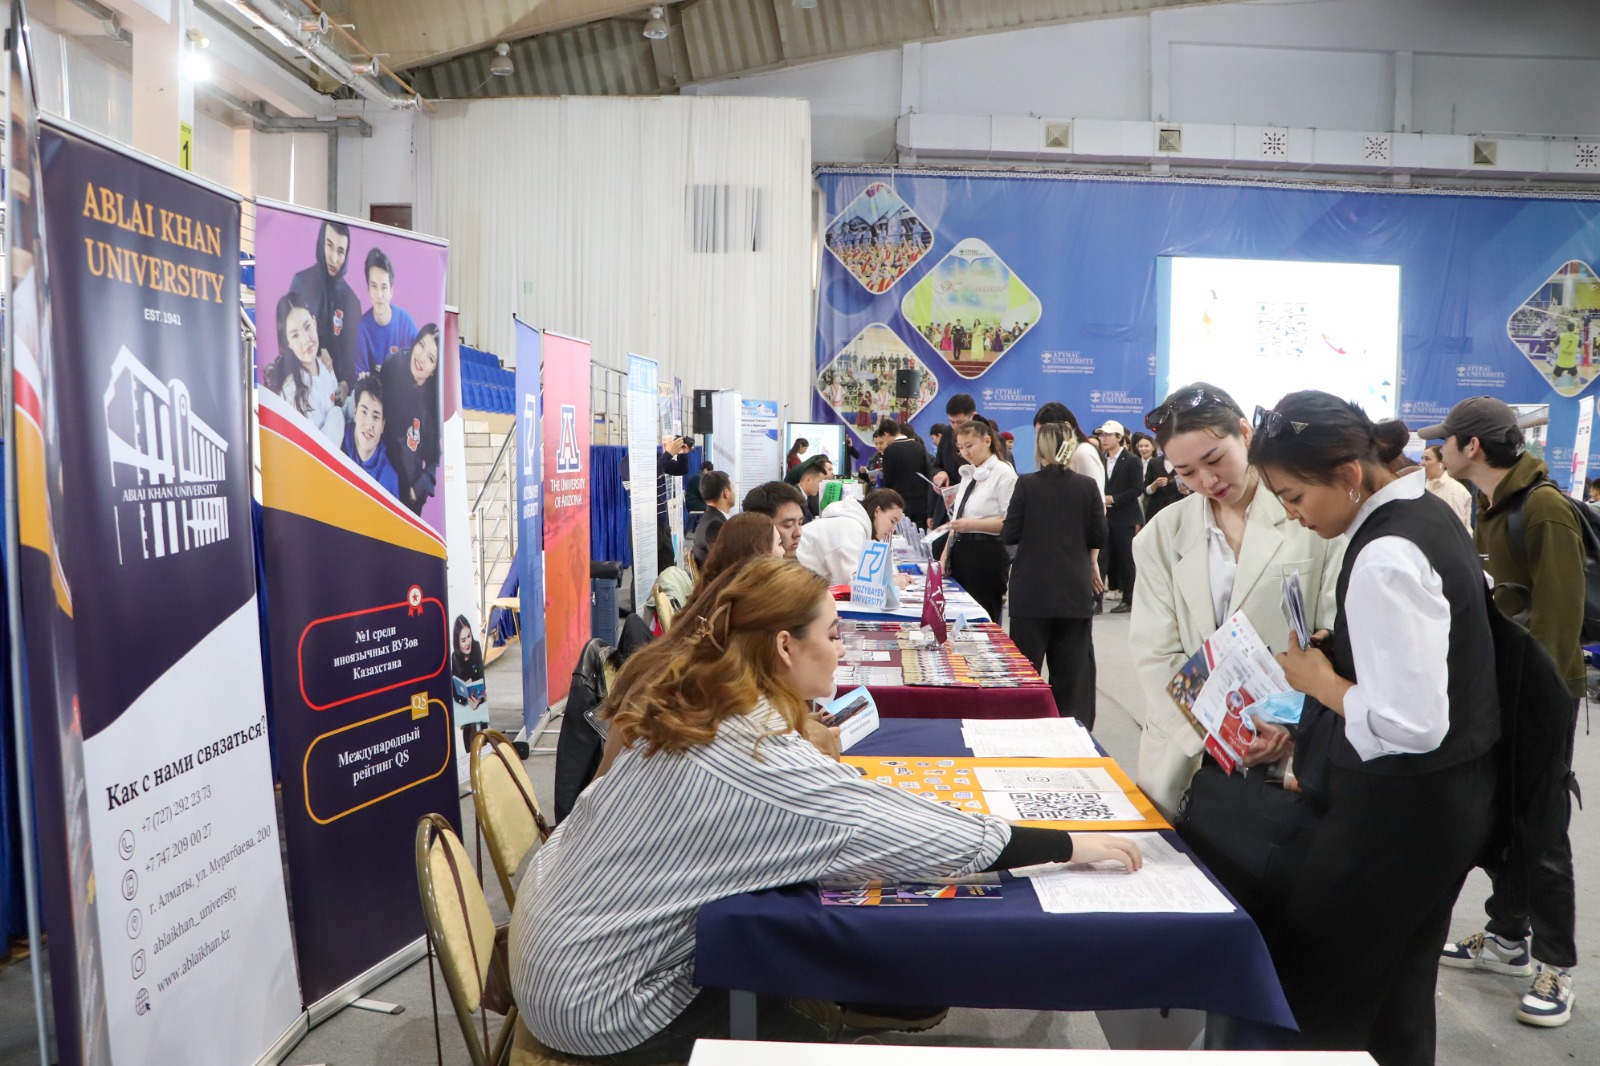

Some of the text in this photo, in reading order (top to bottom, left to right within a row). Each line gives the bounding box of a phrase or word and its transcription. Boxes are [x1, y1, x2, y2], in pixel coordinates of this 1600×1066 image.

[182, 140, 189, 170] 1
[82, 182, 221, 257] ABLAI KHAN
[84, 237, 224, 304] UNIVERSITY
[1053, 357, 1094, 365] UNIVERSITY
[122, 484, 218, 502] ABLAI KHAN UNIVERSITY
[551, 479, 561, 493] THE
[560, 478, 585, 491] UNIVERSITY
[554, 494, 583, 508] OF ARIZONA
[852, 593, 883, 607] UNIVERSITY
[853, 584, 885, 597] KOZYBAYEV
[355, 626, 397, 644] №1 среди
[333, 637, 419, 667] иноязычных ВУЗов
[353, 659, 402, 680] Казахстана
[412, 693, 427, 710] QS
[338, 726, 421, 768] Международный
[106, 715, 266, 811] Как с нами связаться?
[352, 749, 410, 787] рейтинг QS
[141, 784, 212, 832] +7 (727) 292 23 73
[145, 822, 212, 872] +7 747 209 00 27
[149, 824, 271, 916] г. Алматы, ул. Муратбаева, 200
[153, 885, 239, 955] ablaikhan_university
[157, 928, 231, 993] www.ablaikhan.kz
